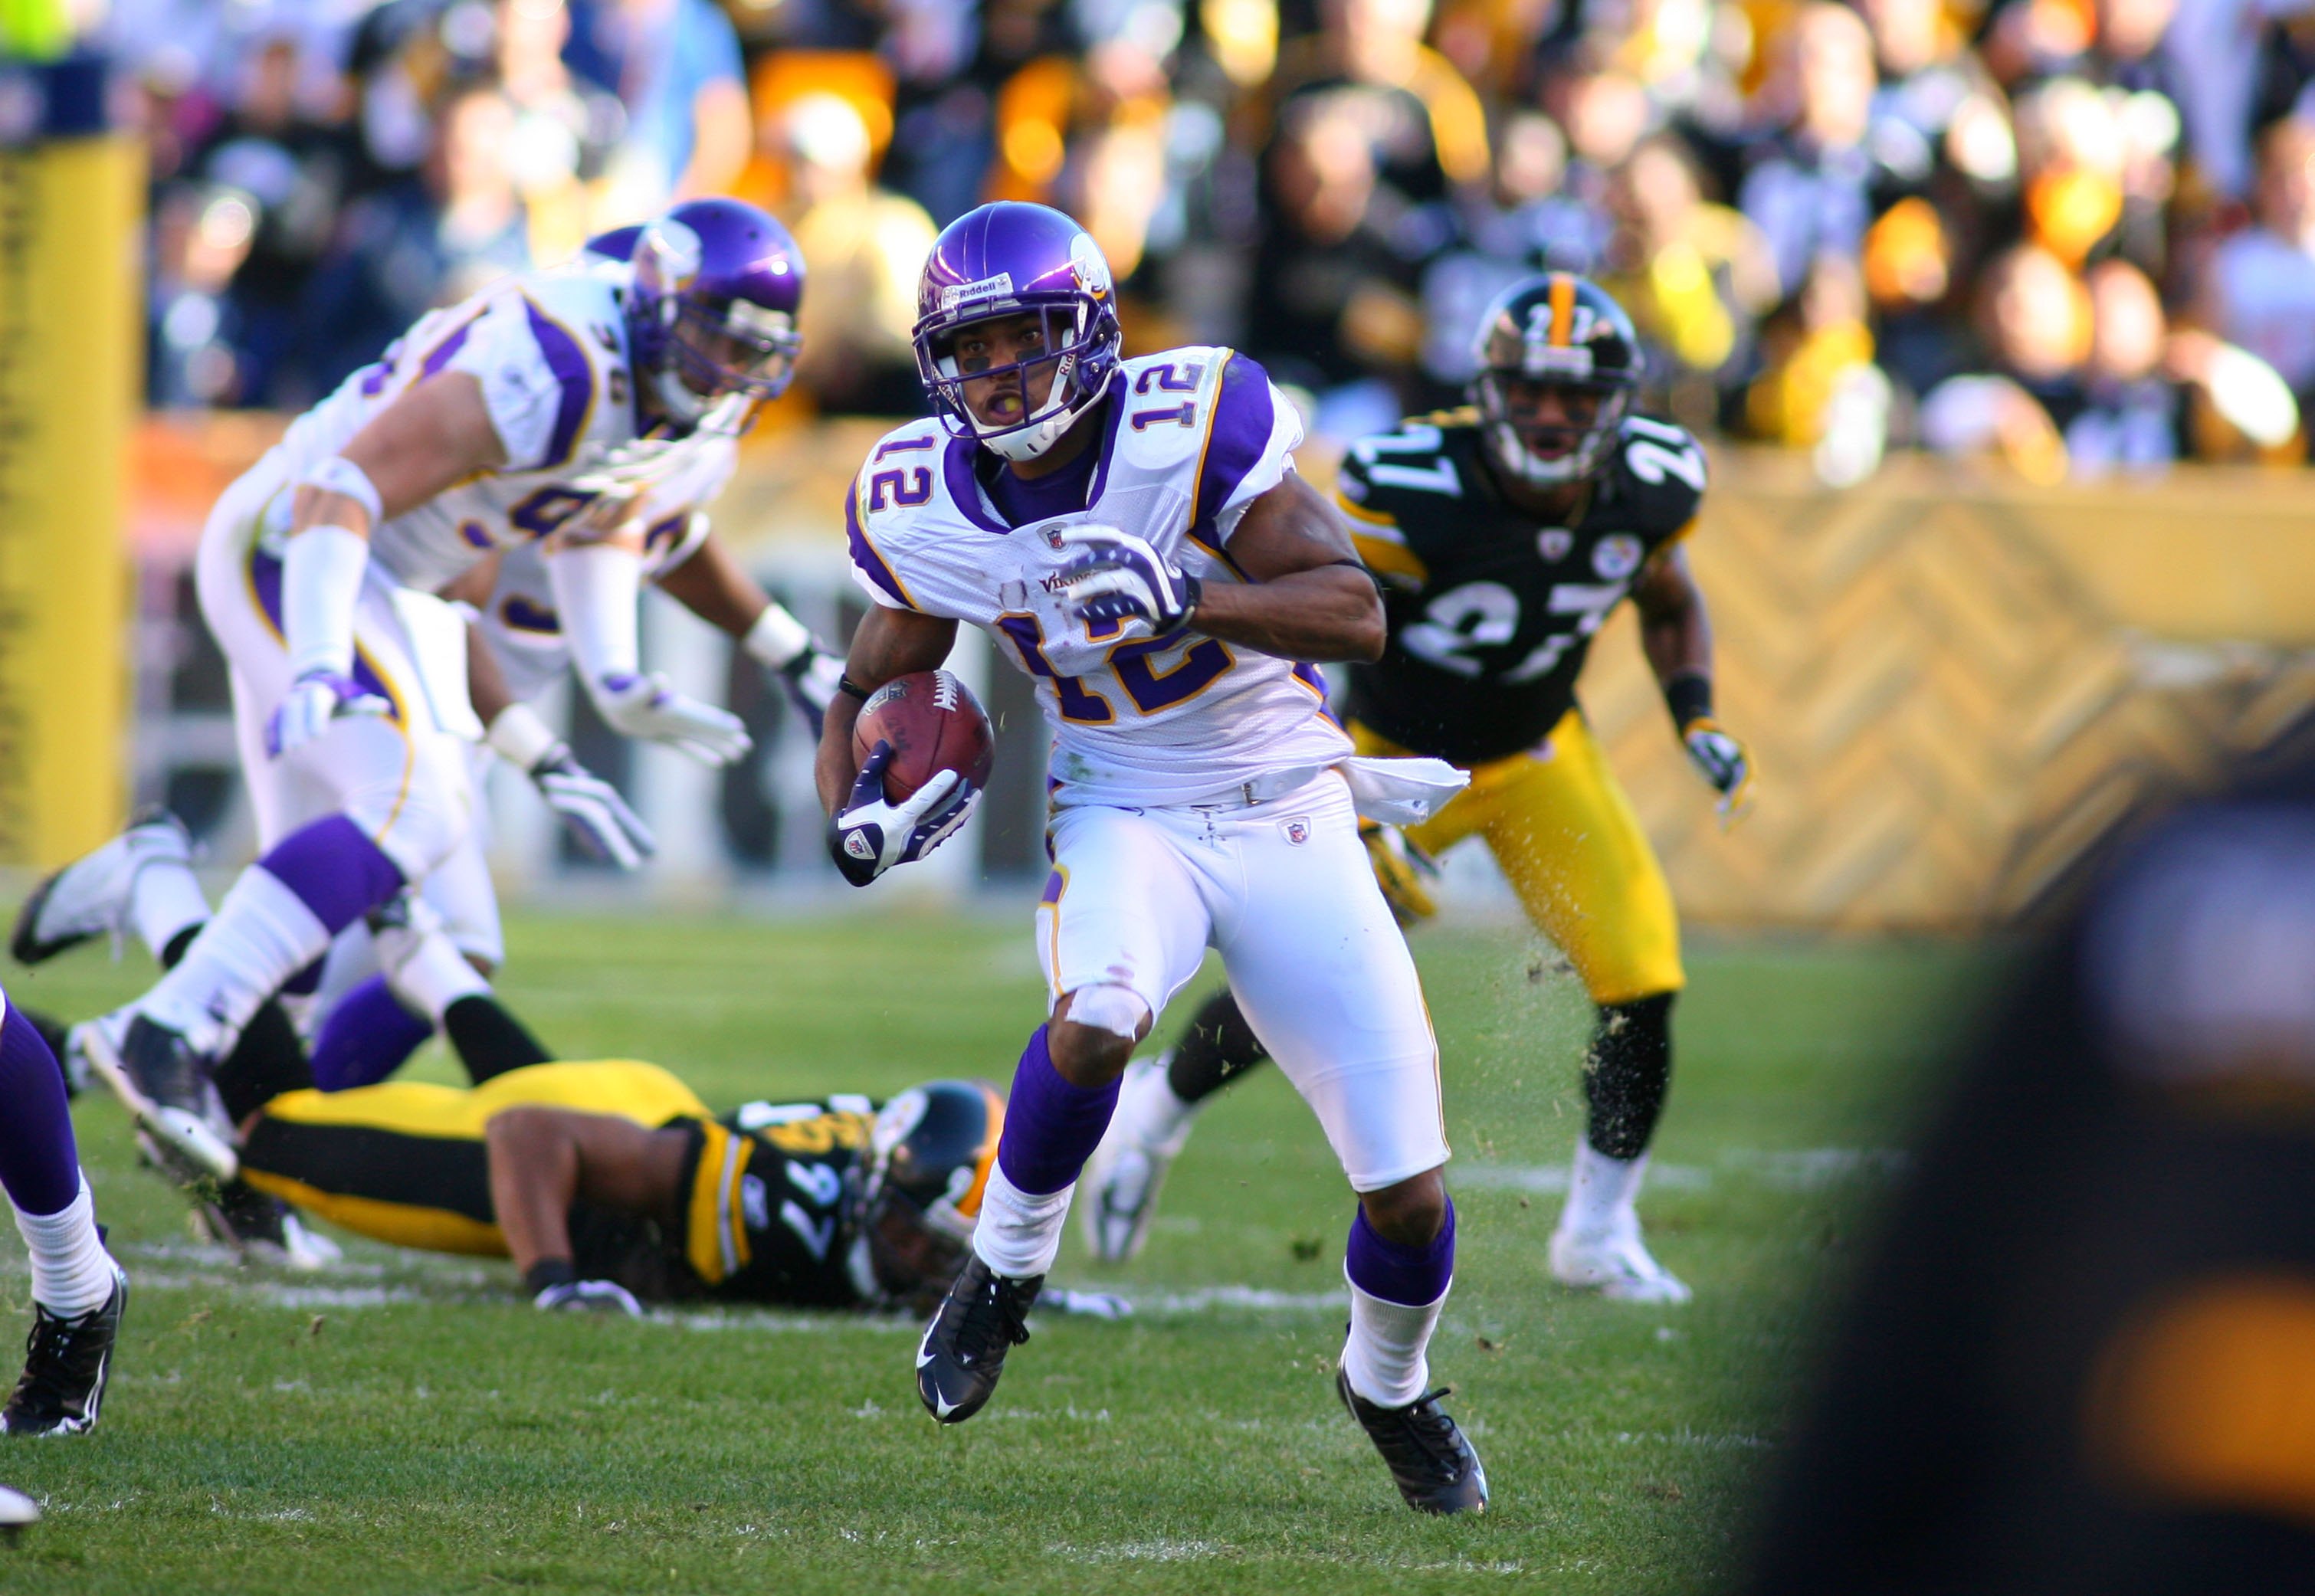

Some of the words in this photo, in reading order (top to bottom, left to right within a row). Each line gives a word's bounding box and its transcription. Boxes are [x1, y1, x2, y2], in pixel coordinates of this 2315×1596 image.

[959, 282, 996, 298] Riddell
[1130, 361, 1206, 434] 12
[871, 434, 938, 513] 12
[994, 600, 1237, 726] 12
[1402, 580, 1631, 679] 27
